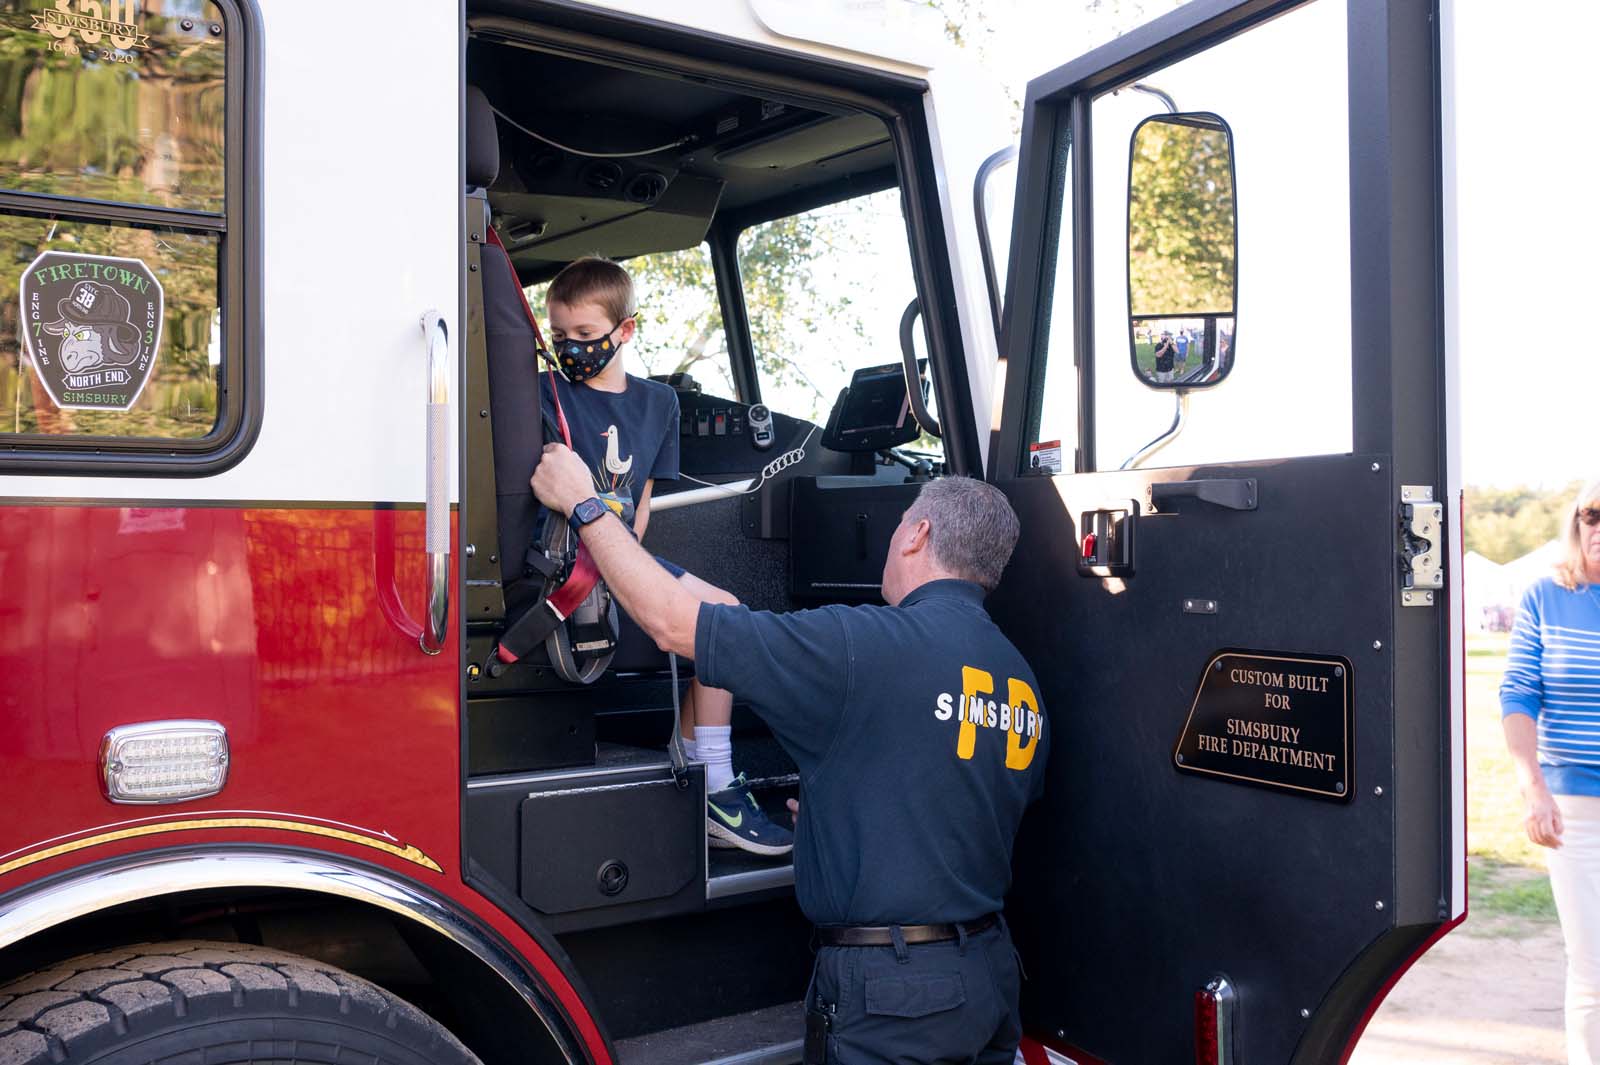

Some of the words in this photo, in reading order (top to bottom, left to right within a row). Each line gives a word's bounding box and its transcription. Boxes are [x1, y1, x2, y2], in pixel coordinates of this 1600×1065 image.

[47, 12, 135, 37] SIMSBURY
[48, 40, 79, 56] 1670
[103, 50, 133, 64] 2020
[34, 263, 150, 295] FIRETOWN
[76, 288, 96, 309] 38
[69, 374, 101, 387] NORTH
[105, 371, 124, 383] END
[63, 393, 128, 405] SIMSBURY
[1231, 669, 1283, 688] CUSTOM
[1288, 674, 1328, 692] BUILT
[1265, 693, 1291, 710] FOR
[934, 692, 1043, 740] SIMSBURY
[1227, 719, 1300, 744] SIMSBURY
[1198, 734, 1228, 754] FIRE
[1232, 740, 1336, 772] DEPARTMENT
